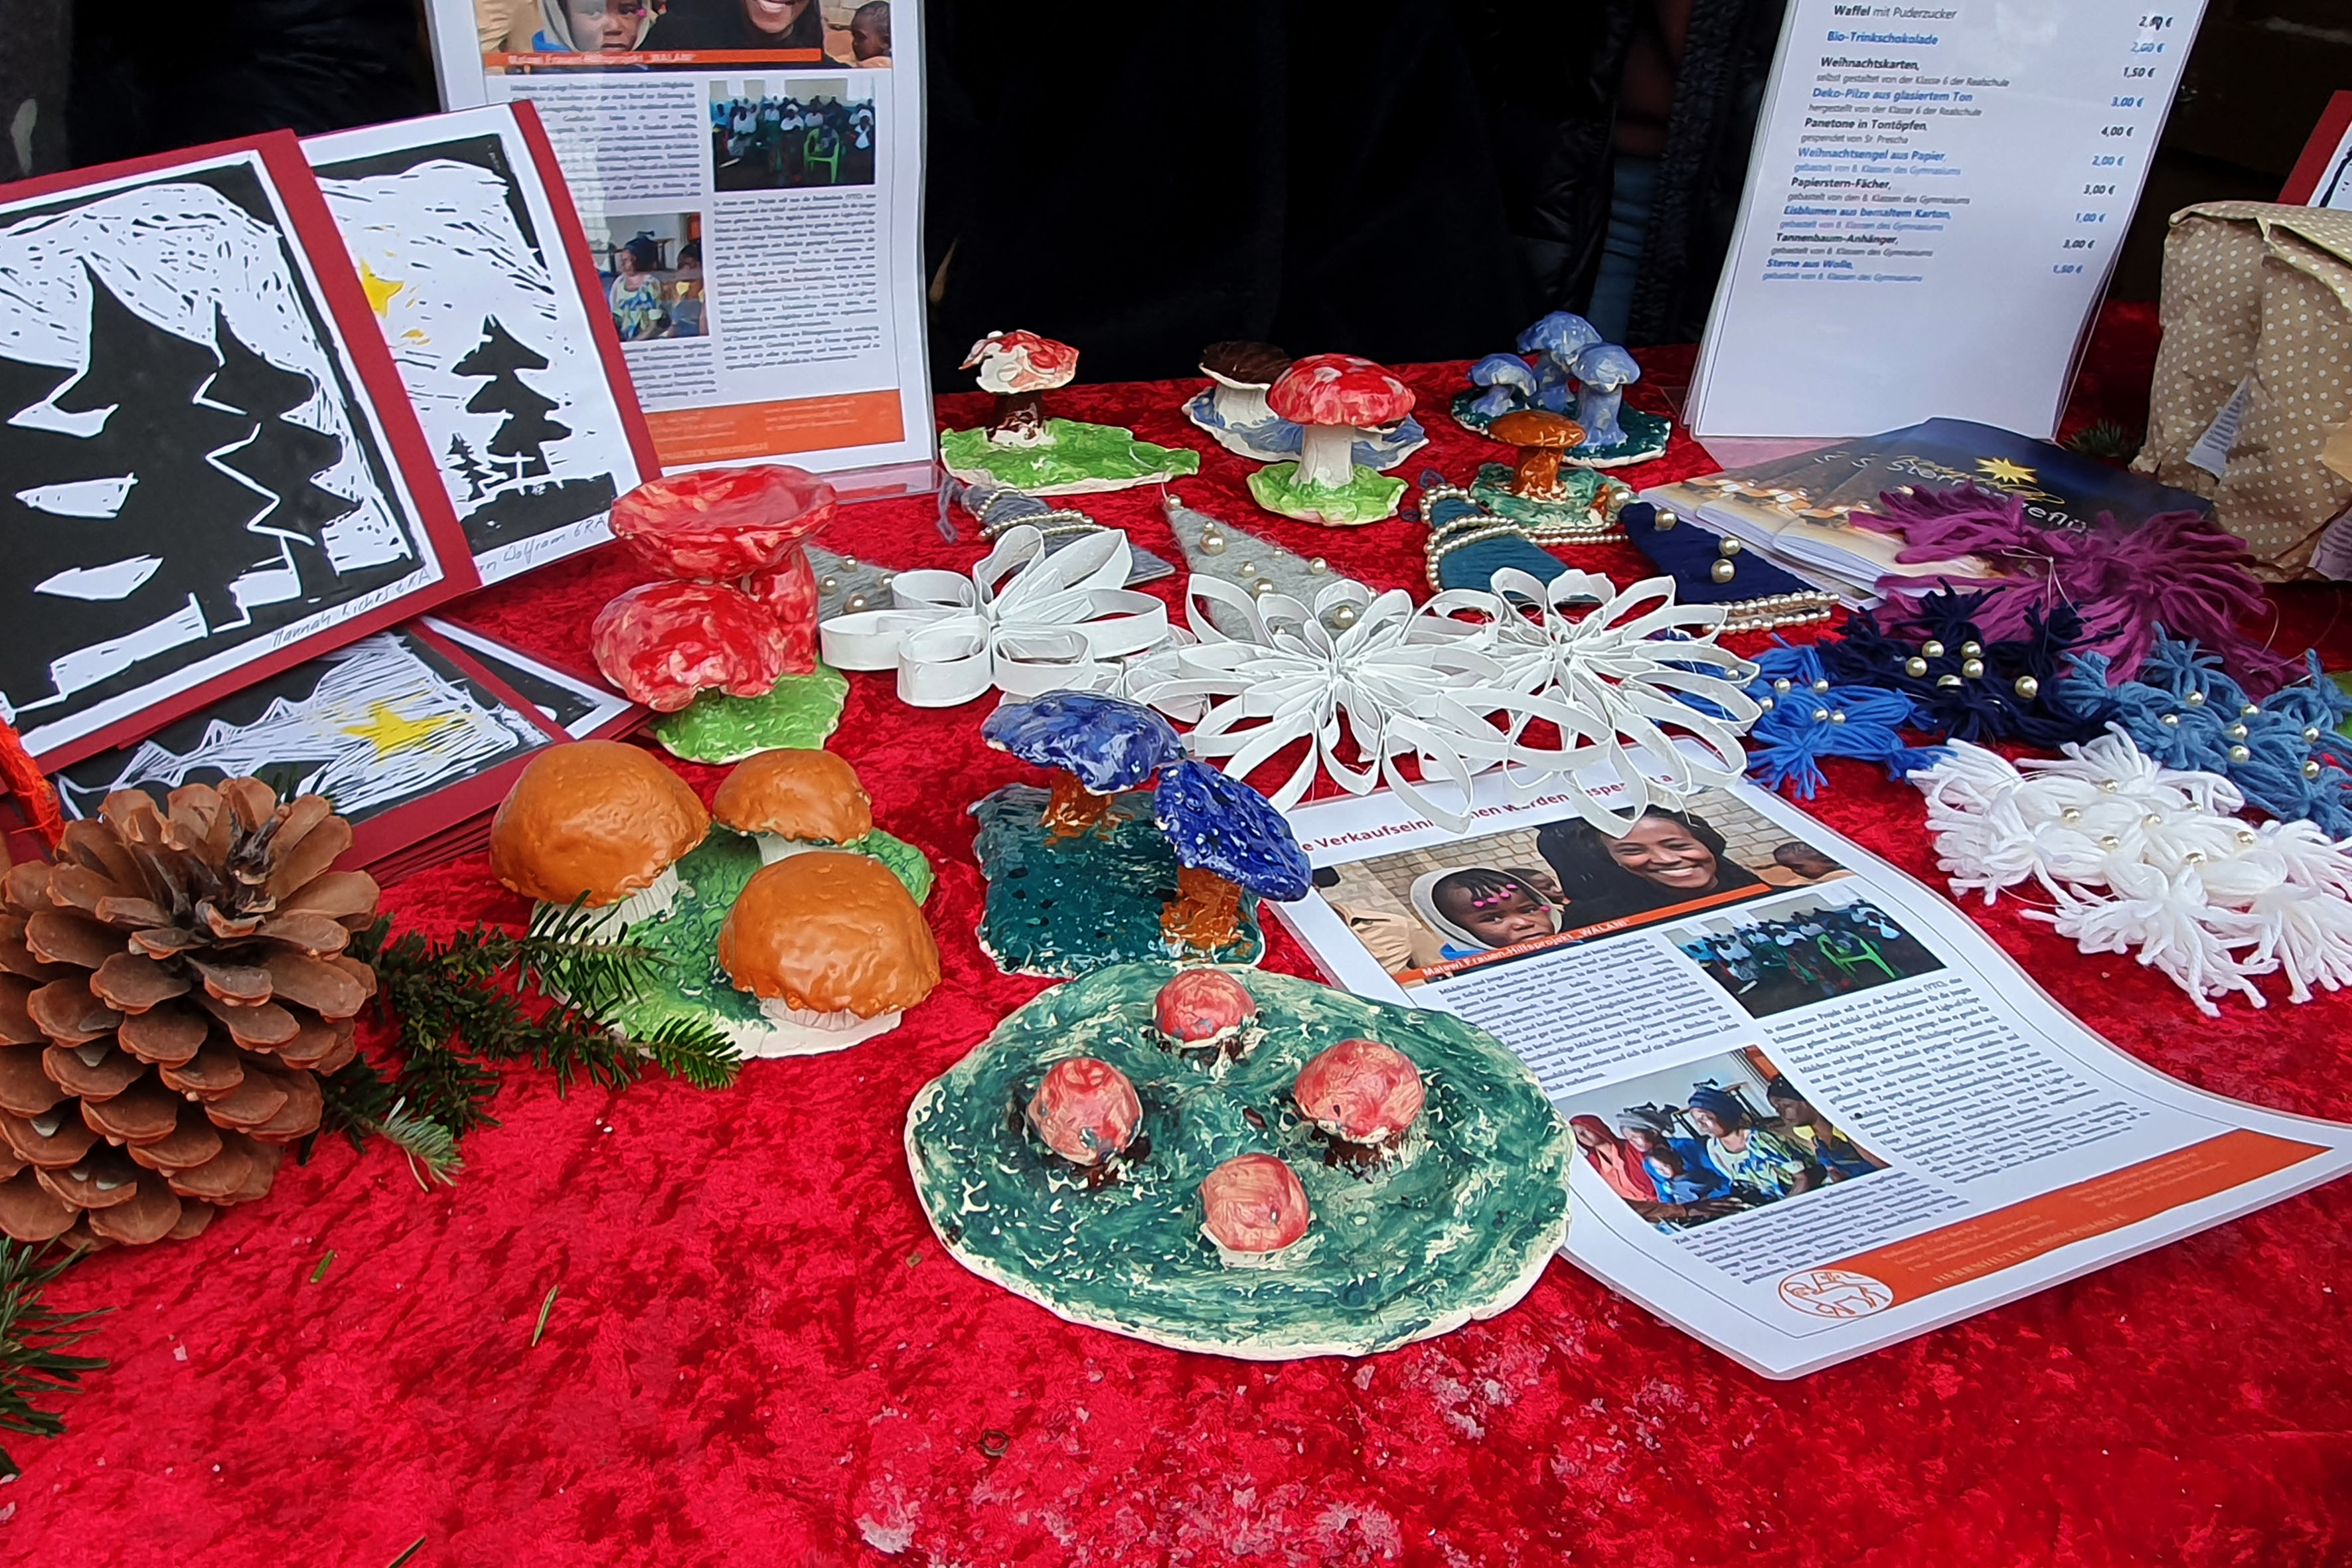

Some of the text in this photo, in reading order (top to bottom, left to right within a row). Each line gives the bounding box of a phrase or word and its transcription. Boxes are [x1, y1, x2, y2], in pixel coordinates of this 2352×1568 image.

[1835, 5, 1957, 19] Waffel mit Puderzucker
[1827, 31, 1938, 44] Bio-Trinkschokolade
[1821, 57, 1919, 71] Weihnachtskarten,
[2124, 67, 2146, 78] 1,50
[1843, 74, 1879, 84] gestaltet
[1966, 78, 2009, 87] Realschule
[1812, 88, 1870, 99] Deko-Pilze
[1893, 90, 1950, 102] glasiertem
[1953, 92, 1973, 102] Ton
[1804, 118, 1855, 128] Panetone
[1857, 119, 1867, 128] in
[1798, 147, 1889, 161] Weihnachtsengel
[1791, 177, 1891, 190] Papierstern-Fächer,
[1784, 206, 1837, 215] Eisblumen
[1766, 259, 1800, 268] Sterne
